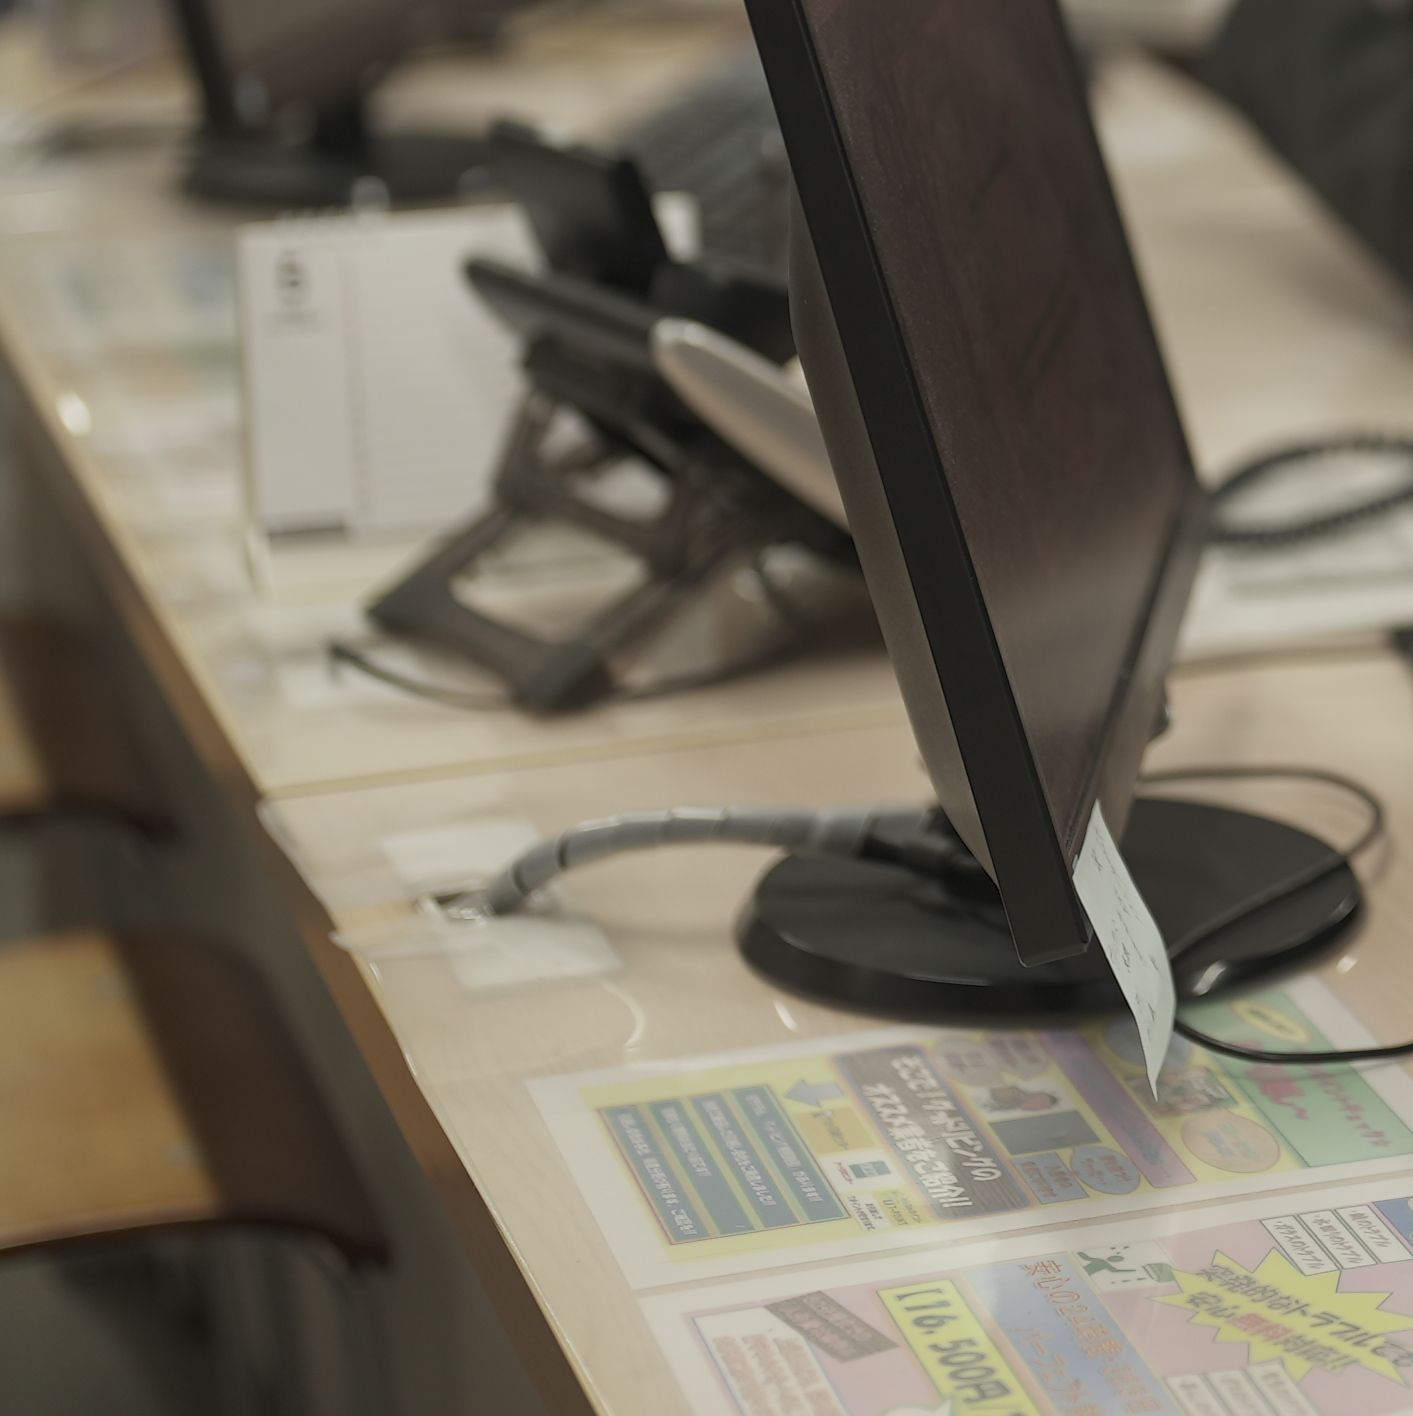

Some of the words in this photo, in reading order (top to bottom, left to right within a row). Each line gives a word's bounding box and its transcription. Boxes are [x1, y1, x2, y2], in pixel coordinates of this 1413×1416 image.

[855, 1080, 976, 1210] オススメ業者をご紹介!!
